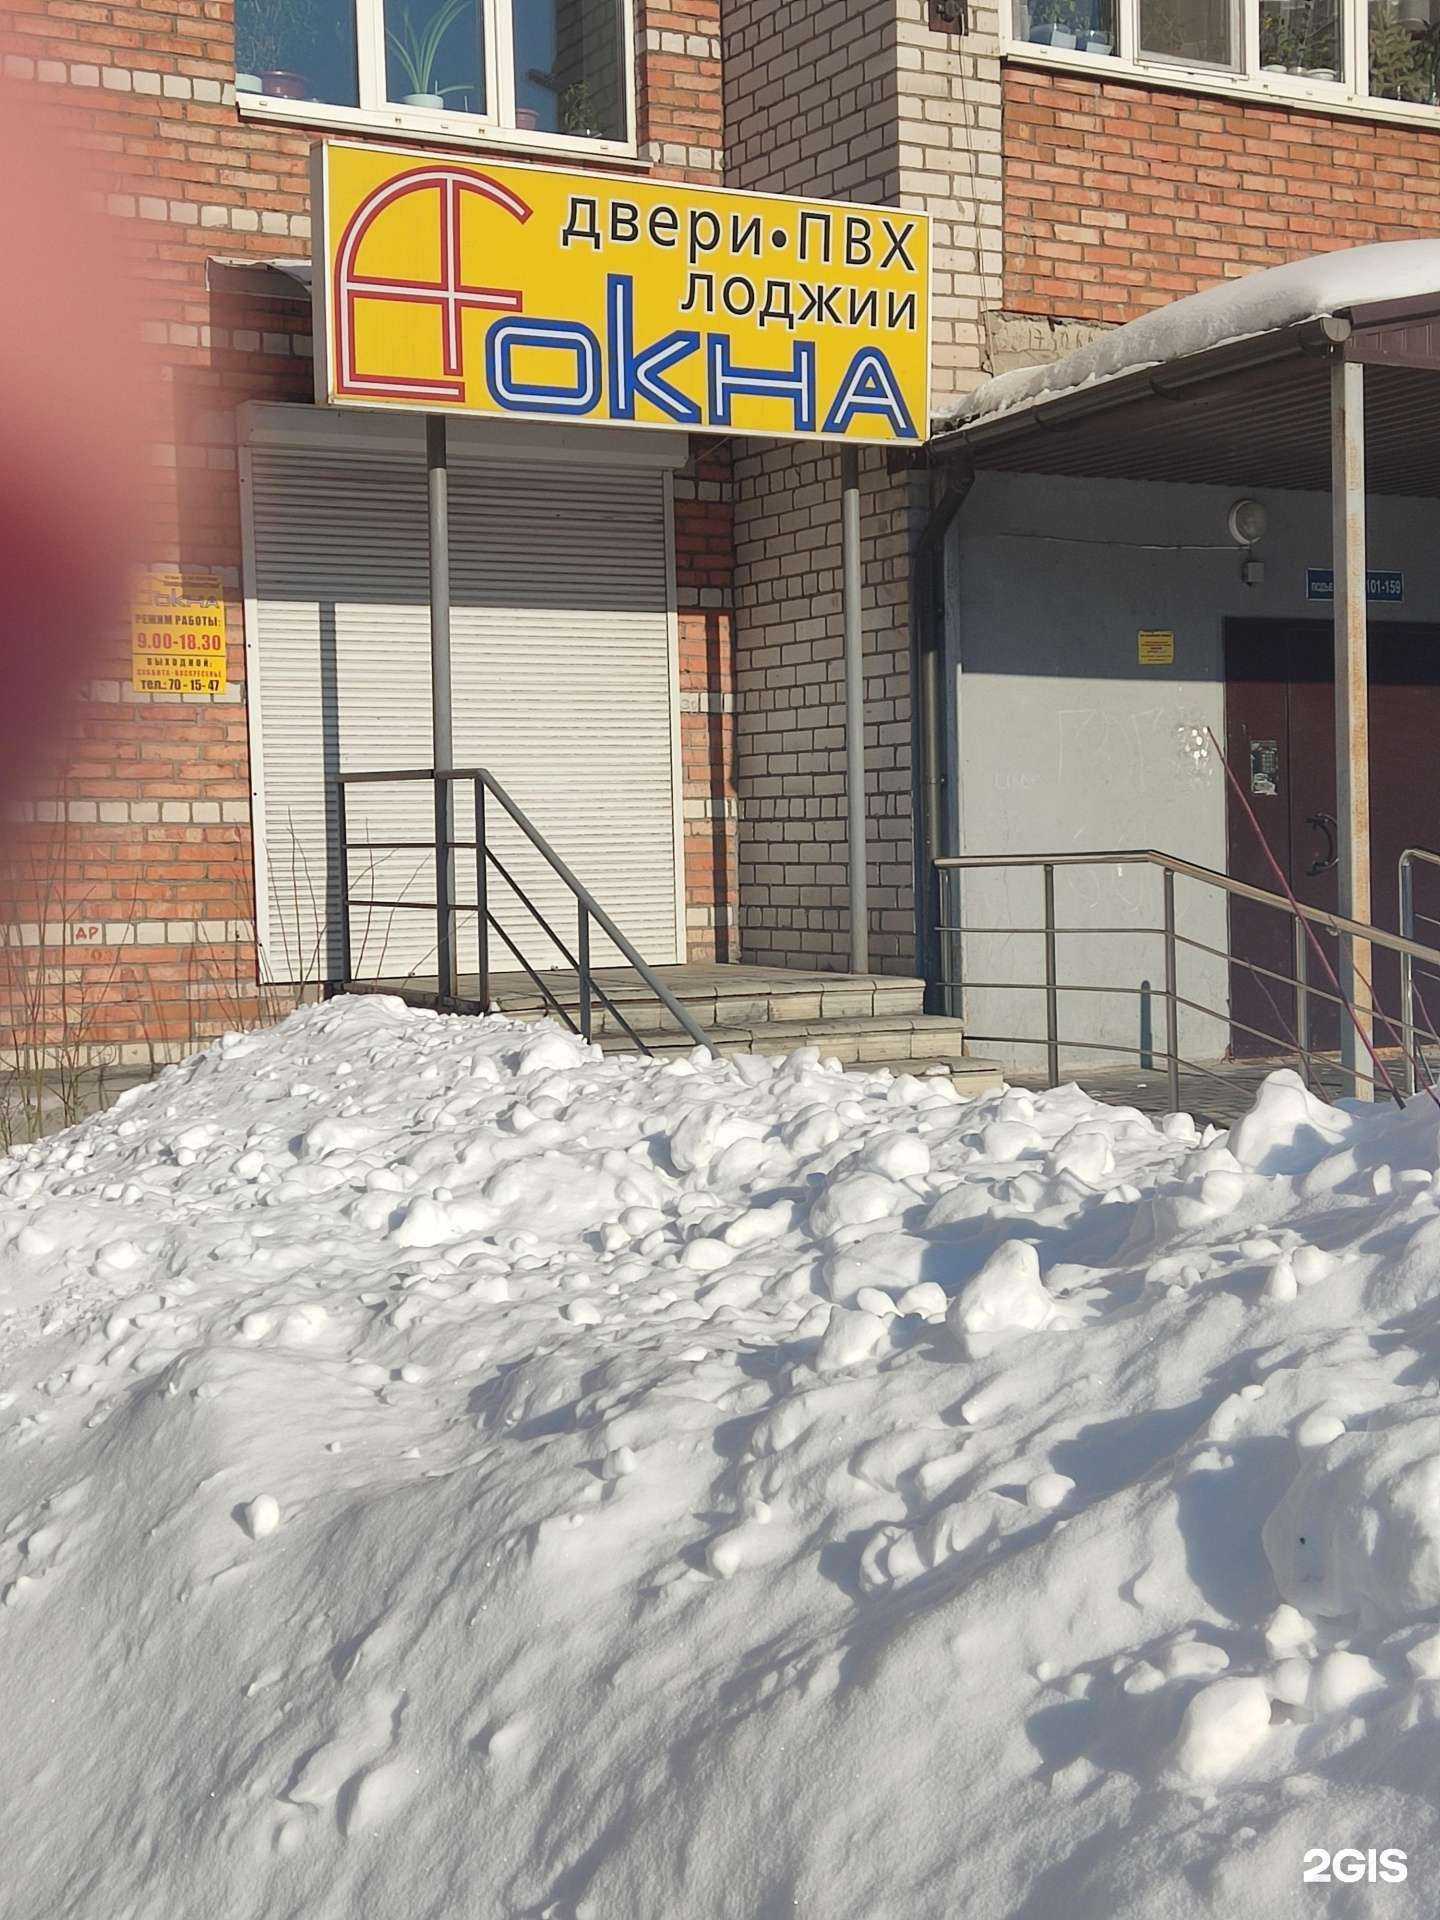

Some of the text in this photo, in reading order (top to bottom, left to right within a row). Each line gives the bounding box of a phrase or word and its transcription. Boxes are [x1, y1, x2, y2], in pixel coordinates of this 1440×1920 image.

[680, 273, 917, 330] лоджии
[136, 614, 172, 625] РЕЖИМ
[137, 632, 221, 651] 9.00-18.30
